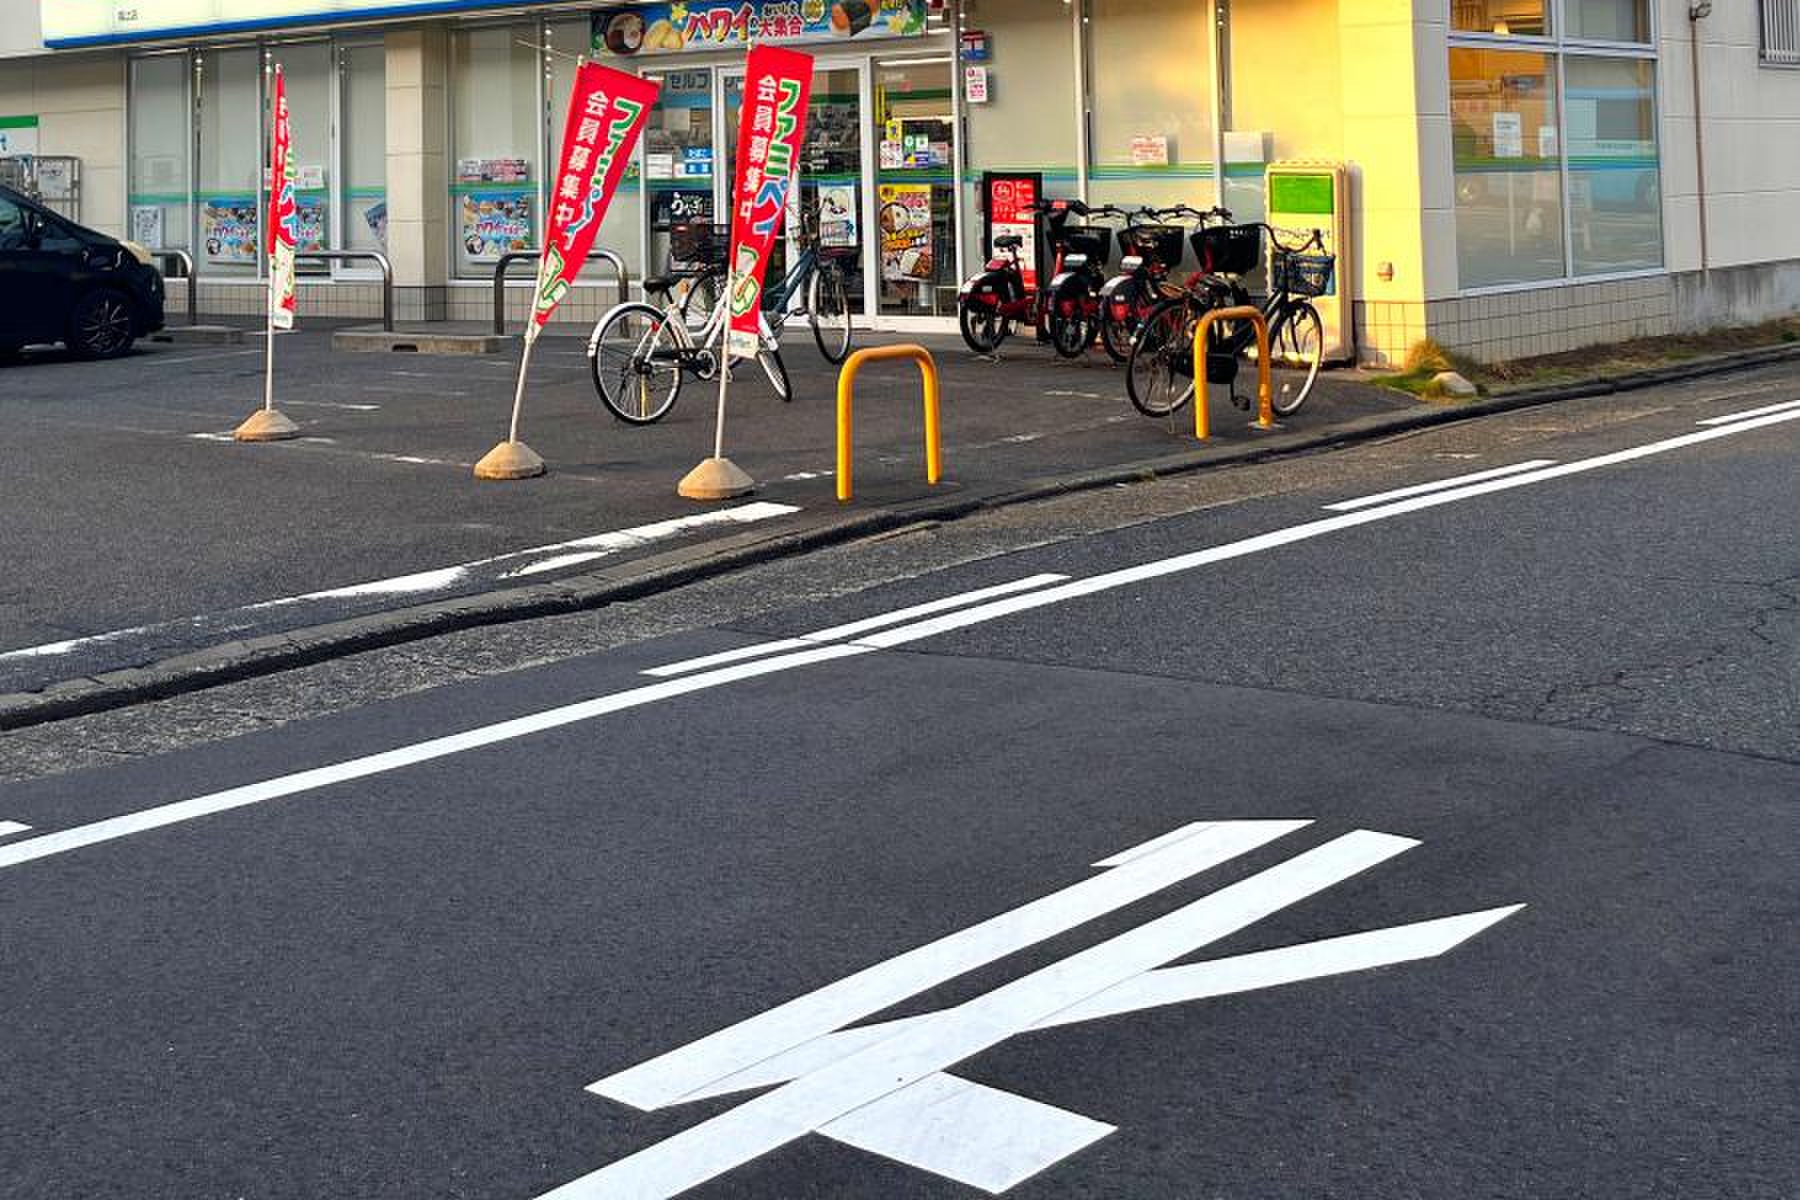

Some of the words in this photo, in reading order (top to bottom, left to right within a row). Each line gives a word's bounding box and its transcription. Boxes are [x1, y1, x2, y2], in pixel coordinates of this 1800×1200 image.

[553, 89, 609, 228] 会員募集中
